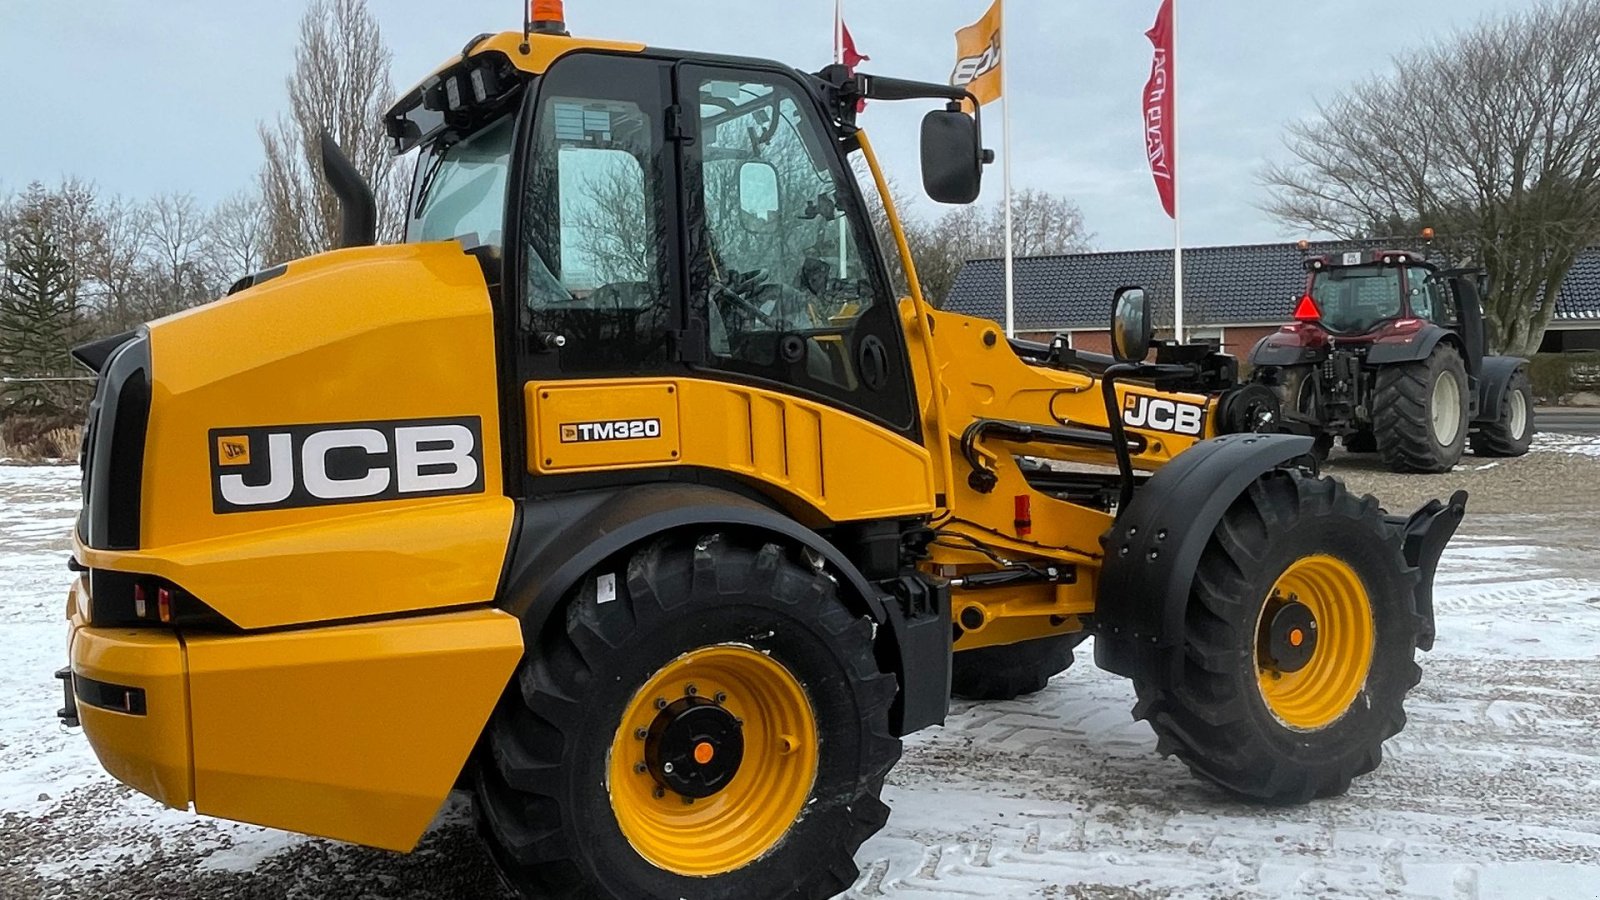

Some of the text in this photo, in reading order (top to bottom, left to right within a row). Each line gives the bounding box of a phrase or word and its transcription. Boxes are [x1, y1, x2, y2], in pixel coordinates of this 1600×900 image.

[578, 420, 659, 440] TM320
[1124, 397, 1201, 434] JCB
[220, 424, 478, 505] JCB
